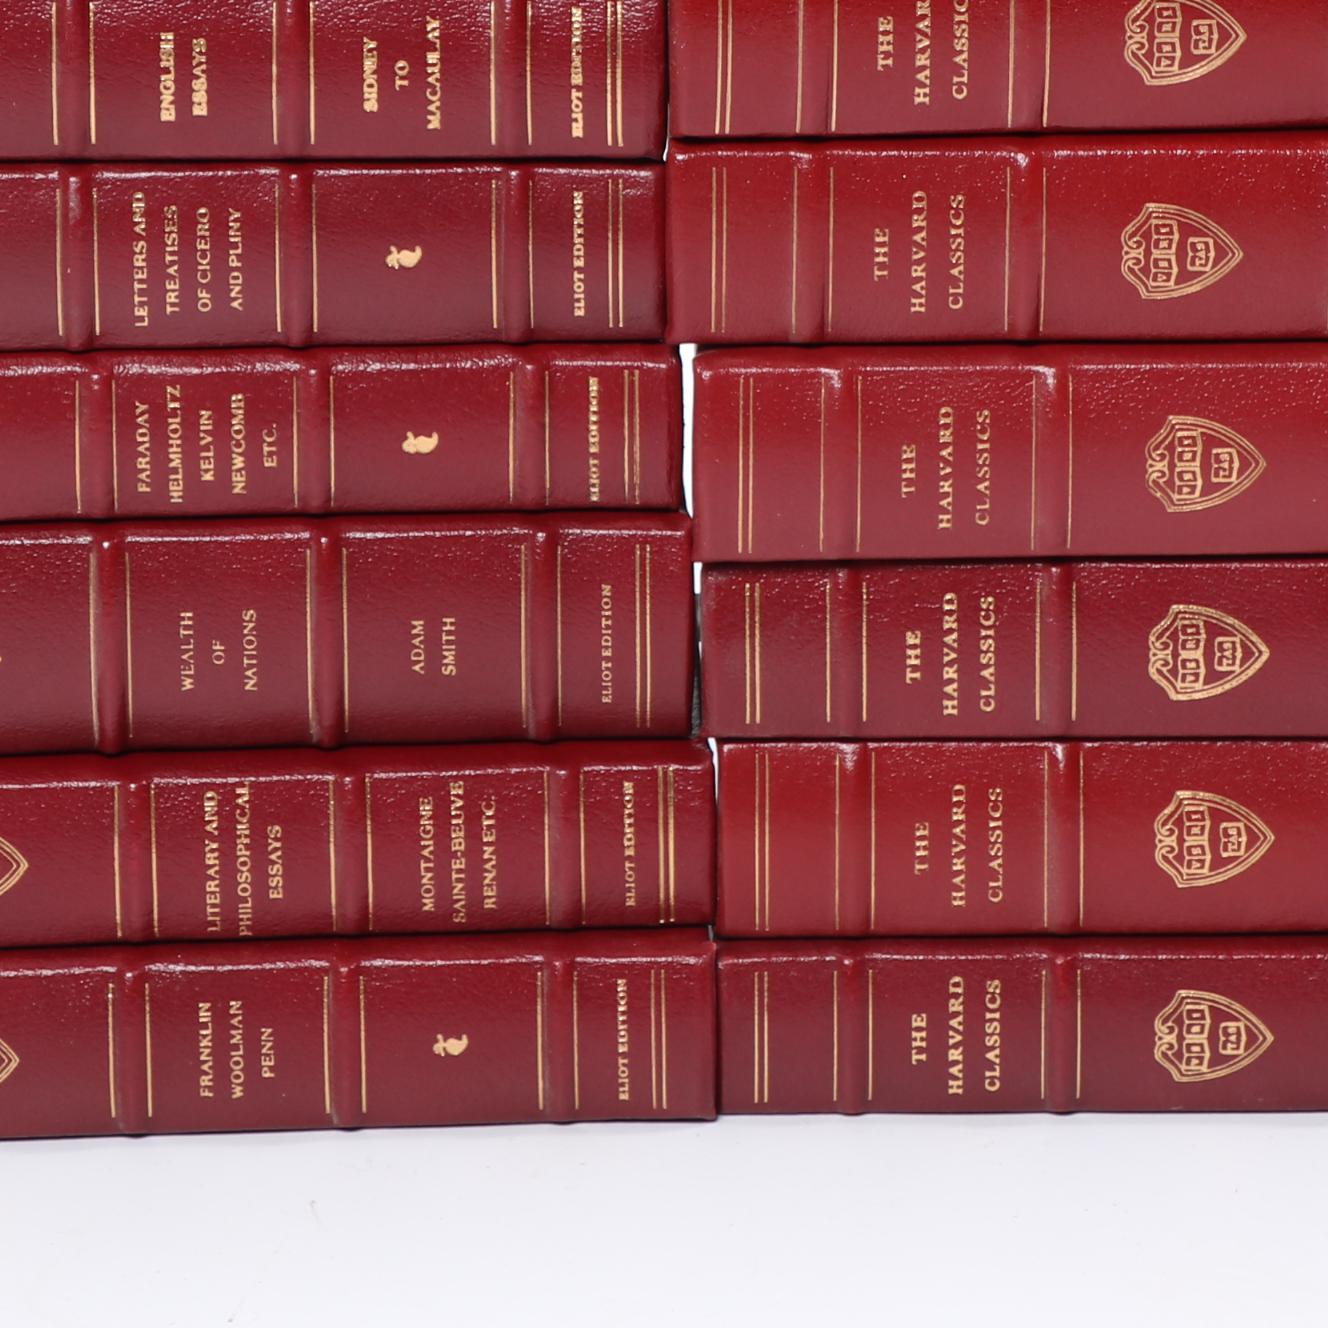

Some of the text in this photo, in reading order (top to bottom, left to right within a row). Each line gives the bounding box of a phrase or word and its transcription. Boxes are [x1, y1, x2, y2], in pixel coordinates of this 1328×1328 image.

[160, 32, 175, 122] ENGLISH
[192, 38, 208, 116] ESSAYS
[363, 37, 379, 113] SIDNEY
[395, 60, 410, 90] TO
[425, 16, 441, 129] MACAULAY
[877, 15, 893, 71] THE
[132, 192, 148, 327] LETTERS AND
[164, 205, 180, 315] TREATISES
[196, 207, 211, 312] OF CICERO
[228, 208, 243, 311] AND PLINY
[873, 228, 889, 281] THE
[911, 190, 927, 312] HARVARD
[948, 193, 965, 310] CLASSICS
[135, 401, 151, 492] FARADAY
[166, 384, 183, 503] HELMHOLTZ
[199, 409, 214, 481] KELVIN
[230, 393, 246, 494] NEWCOMB
[262, 423, 278, 468] ETC.
[900, 444, 916, 498] THE
[938, 406, 954, 529] HARVARD
[975, 409, 991, 526] CLASSICS
[179, 611, 195, 691] WEALTH
[210, 640, 226, 665] OF
[242, 609, 257, 691] NATIONS
[410, 619, 425, 674] ADAM
[441, 617, 456, 676] SMITH
[601, 583, 612, 703] ELIOT EDITION
[905, 630, 921, 684] THE
[943, 592, 959, 716] HARVARD
[980, 594, 996, 712] CLASSICS
[204, 791, 220, 932] LITERARY AND
[236, 781, 252, 936] PHILOSOPHICAL
[267, 825, 283, 900] ESSAYS
[419, 796, 435, 912] MONTAIGNE
[450, 780, 466, 923] SAINTE-BEUVE
[481, 795, 498, 910] RENAN ETC.
[914, 822, 929, 875] THE
[951, 784, 966, 906] HARVARD
[987, 787, 1003, 903] CLASSICS
[197, 1001, 214, 1098] FRANKLIN
[228, 999, 244, 1100] WOOLMAN
[260, 1027, 275, 1078] PENN
[911, 1013, 927, 1065] THE
[948, 975, 964, 1095] HARVARD
[985, 979, 1001, 1092] CLASSICS
